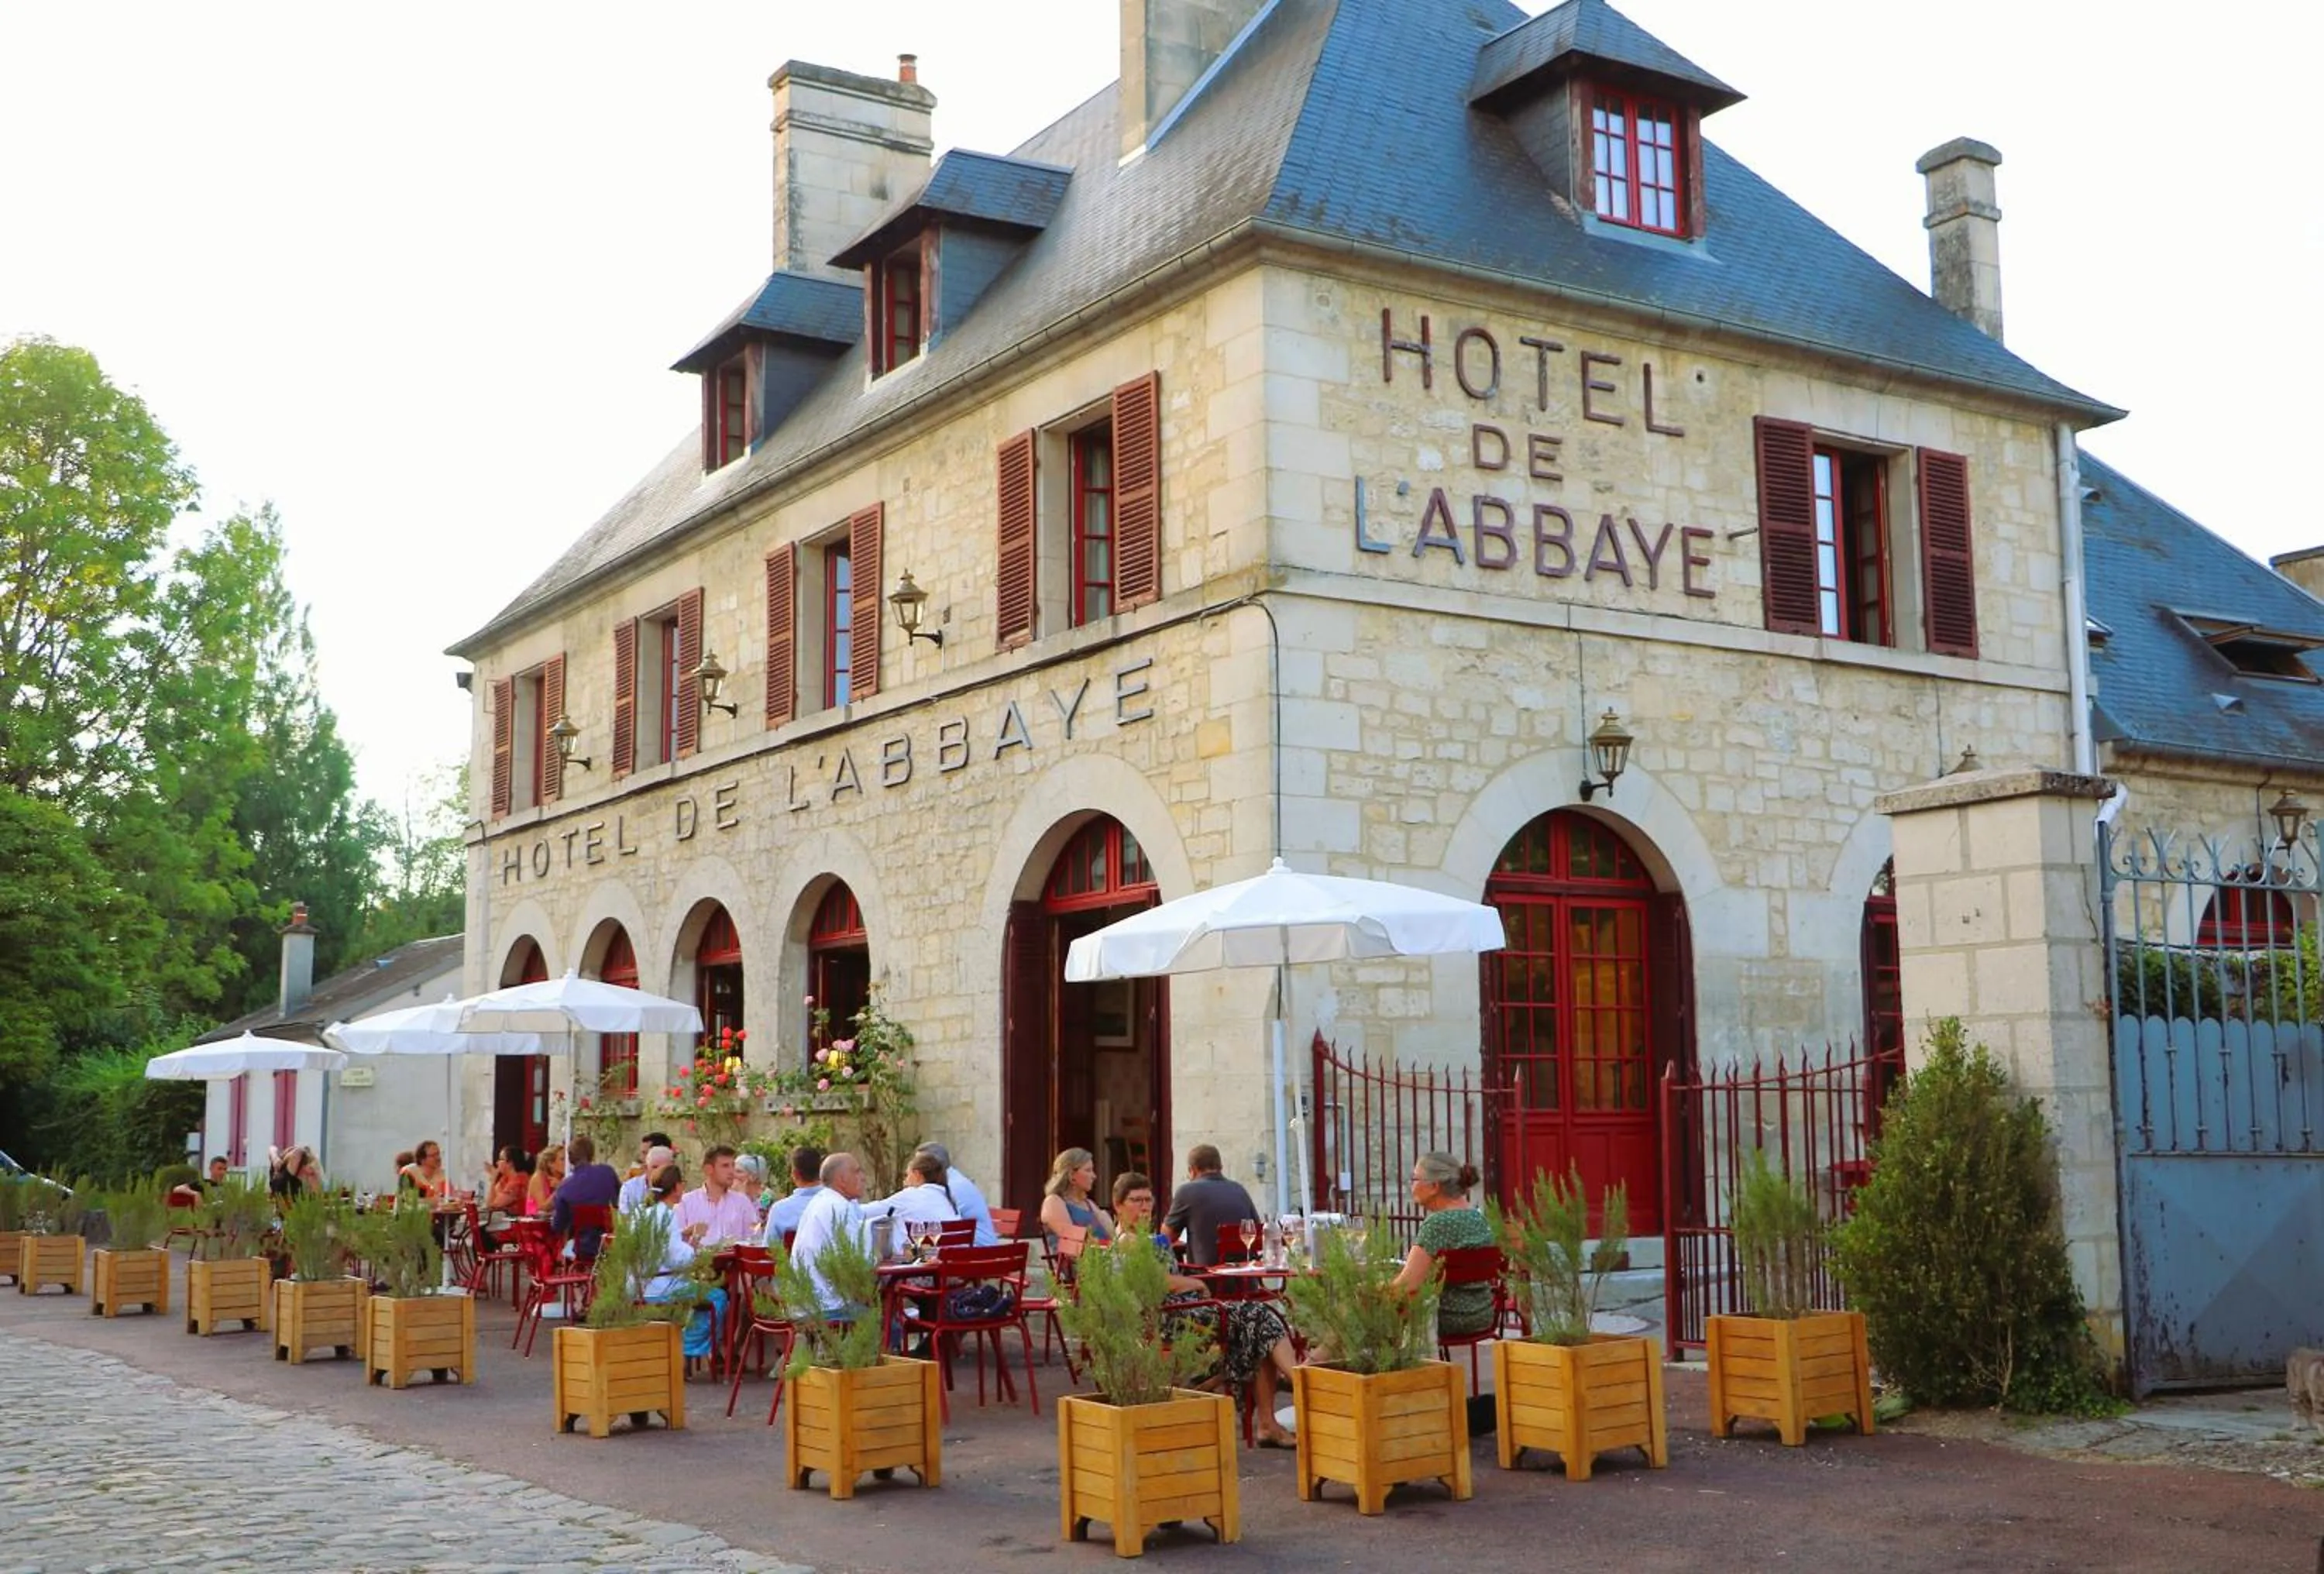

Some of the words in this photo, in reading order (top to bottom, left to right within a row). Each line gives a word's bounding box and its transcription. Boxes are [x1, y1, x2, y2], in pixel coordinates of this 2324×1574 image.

[1382, 308, 1684, 437] HOTEL
[1473, 424, 1563, 481] DE
[1355, 476, 1716, 598] L'ABBAYE
[503, 816, 638, 886] HOTEL
[676, 780, 739, 842] DE
[788, 658, 1154, 812] L'ABBAYE
